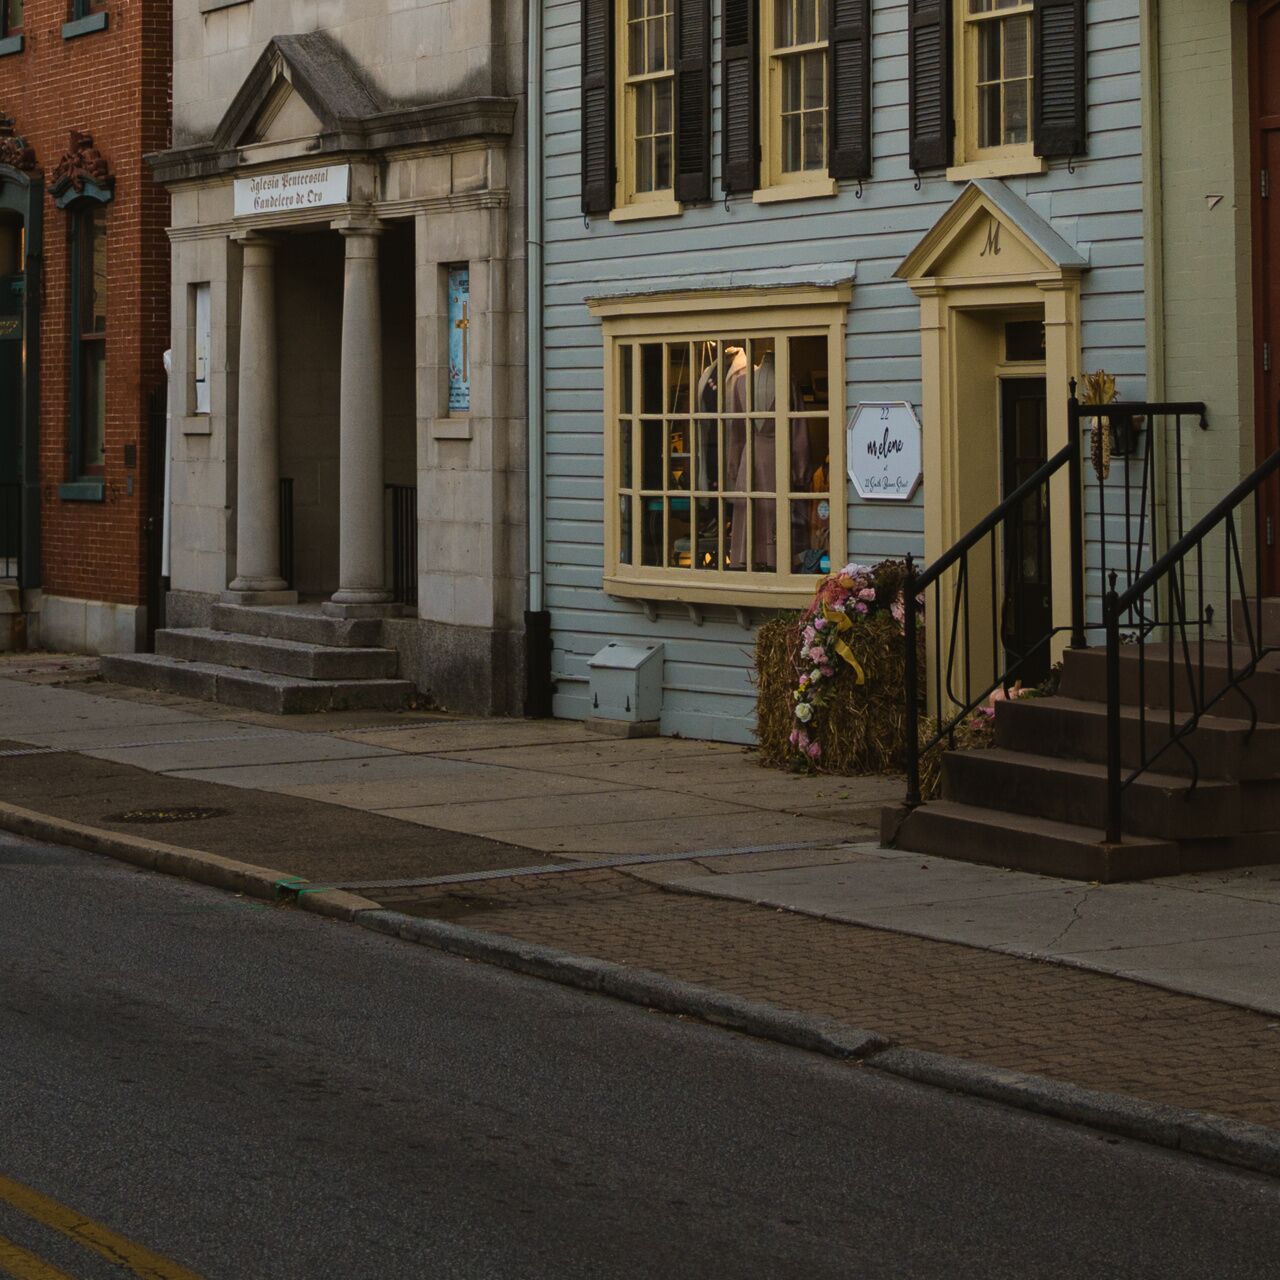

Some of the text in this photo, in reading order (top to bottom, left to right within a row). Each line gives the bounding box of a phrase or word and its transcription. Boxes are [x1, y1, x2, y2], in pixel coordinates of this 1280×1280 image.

[251, 168, 329, 195] Iglesia Pentecostal
[254, 189, 322, 210] Candelero de Oro
[980, 218, 1001, 257] M
[880, 407, 889, 420] 22
